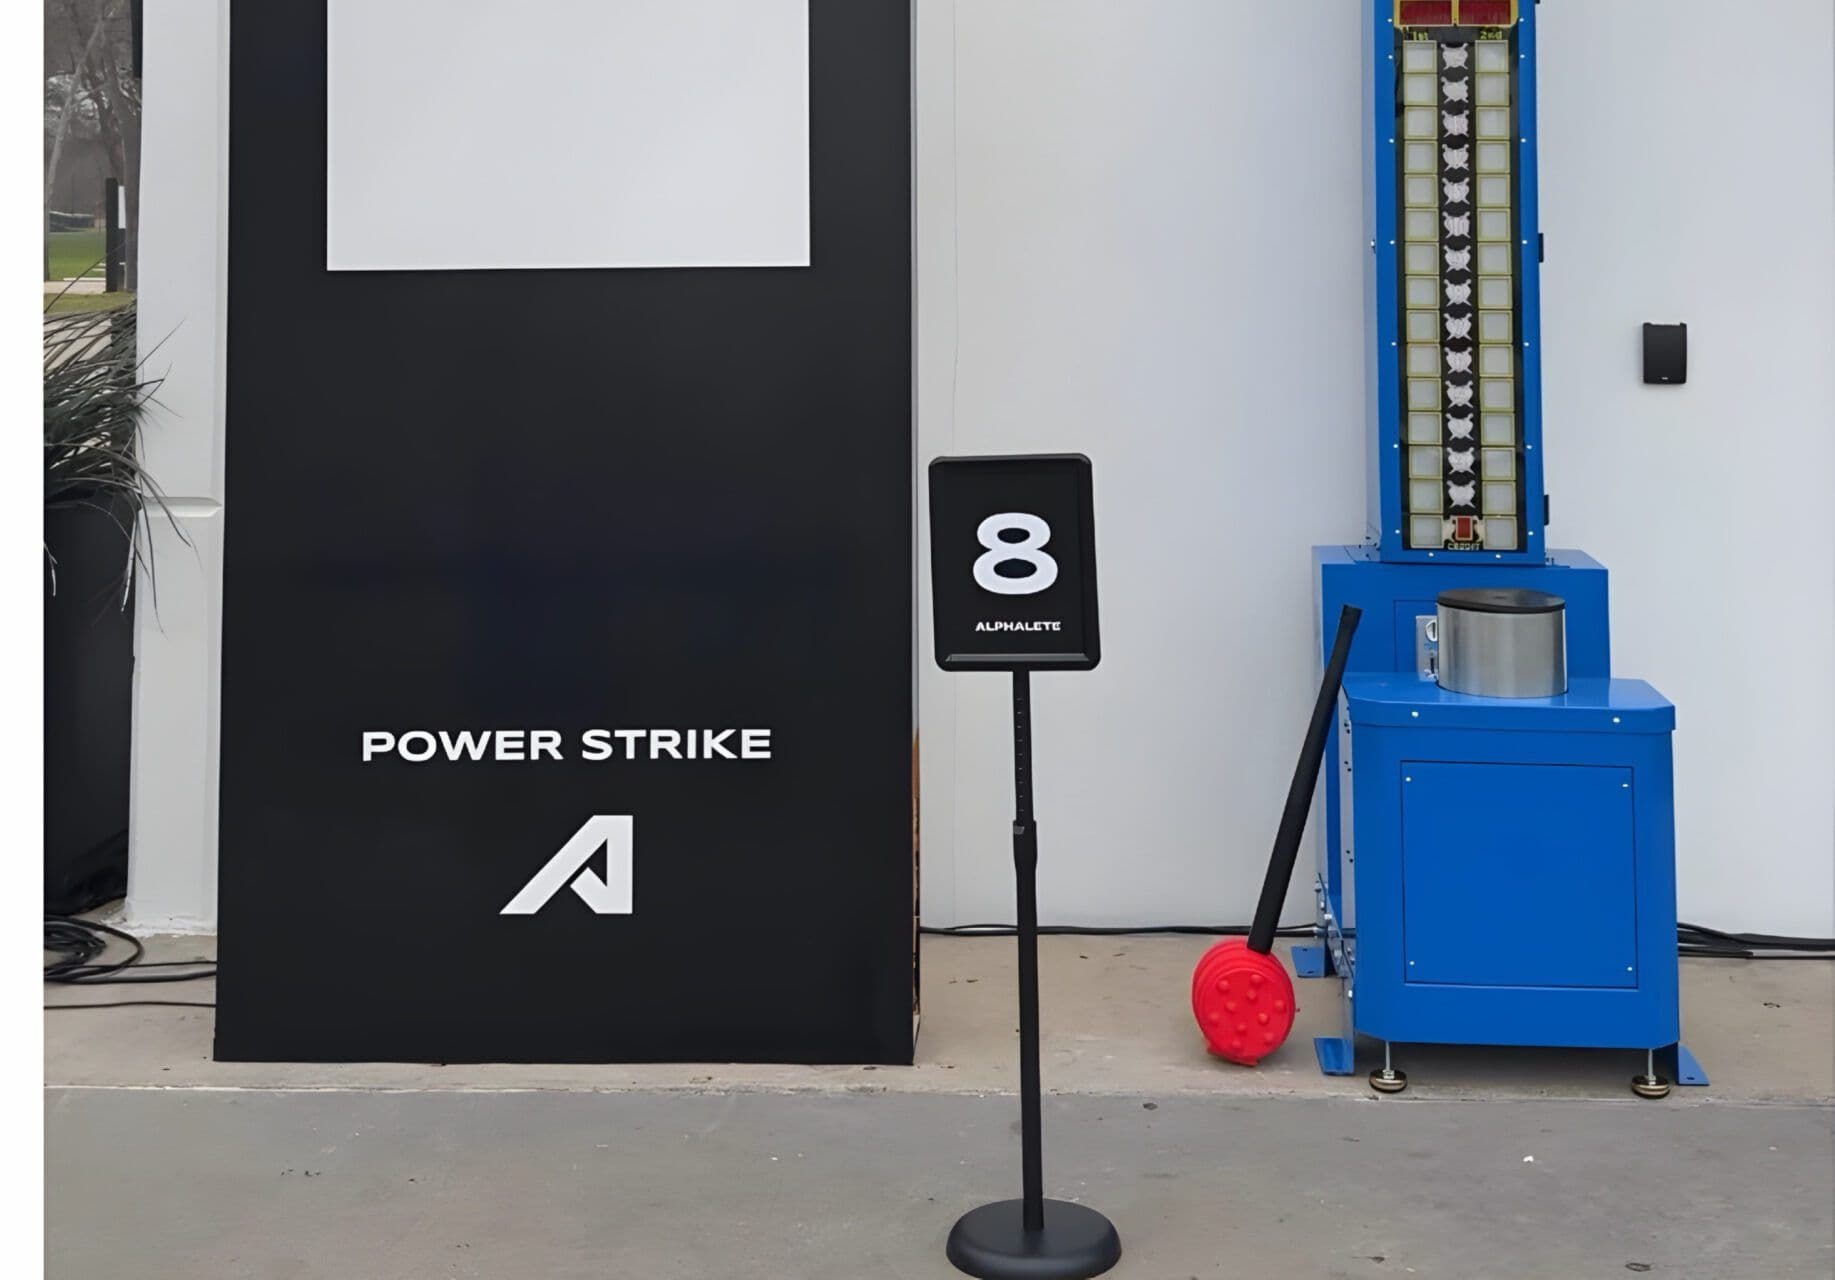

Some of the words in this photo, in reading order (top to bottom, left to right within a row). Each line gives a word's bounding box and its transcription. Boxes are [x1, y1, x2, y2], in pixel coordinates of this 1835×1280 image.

[972, 512, 1059, 595] 8
[974, 620, 1062, 632] ALPHALETE
[362, 730, 564, 762] POWER
[581, 728, 772, 761] STRIKE
